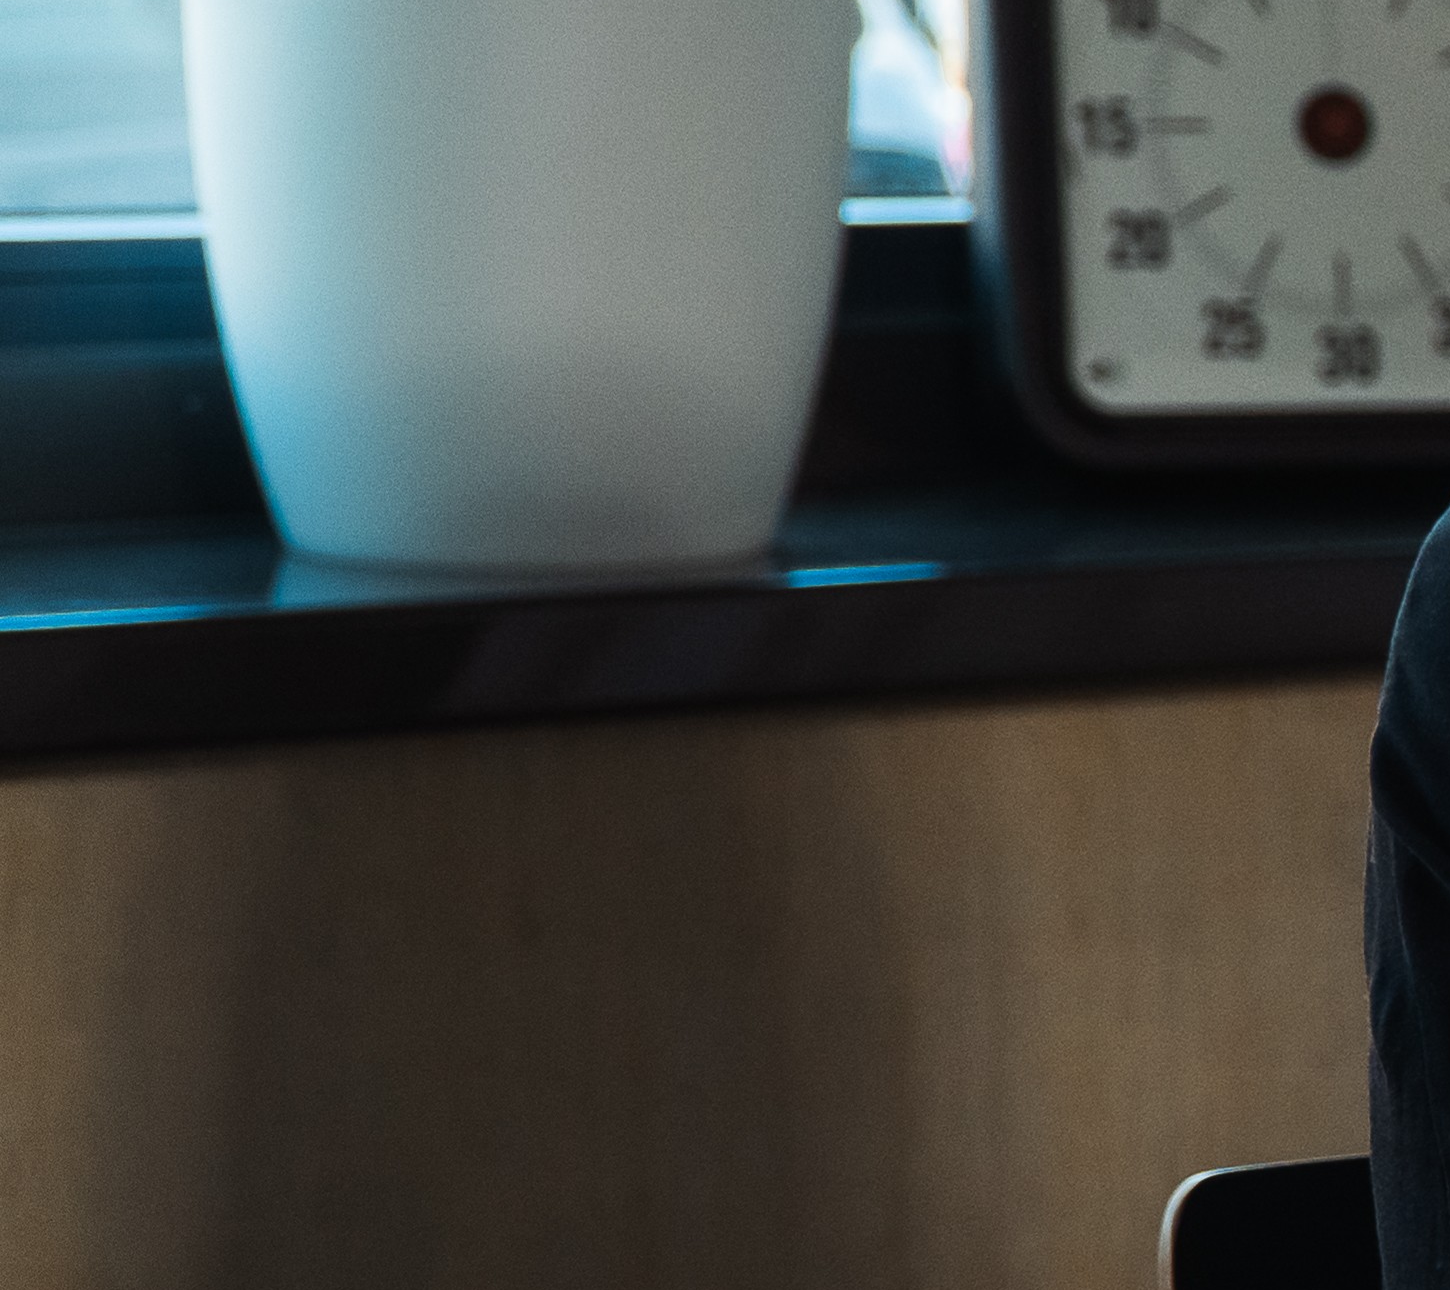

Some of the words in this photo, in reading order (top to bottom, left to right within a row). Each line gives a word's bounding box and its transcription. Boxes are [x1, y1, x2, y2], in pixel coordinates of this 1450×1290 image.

[1076, 94, 1139, 159] 15
[1106, 209, 1172, 271] 20
[1202, 295, 1267, 361] 25
[1315, 322, 1383, 388] 30
